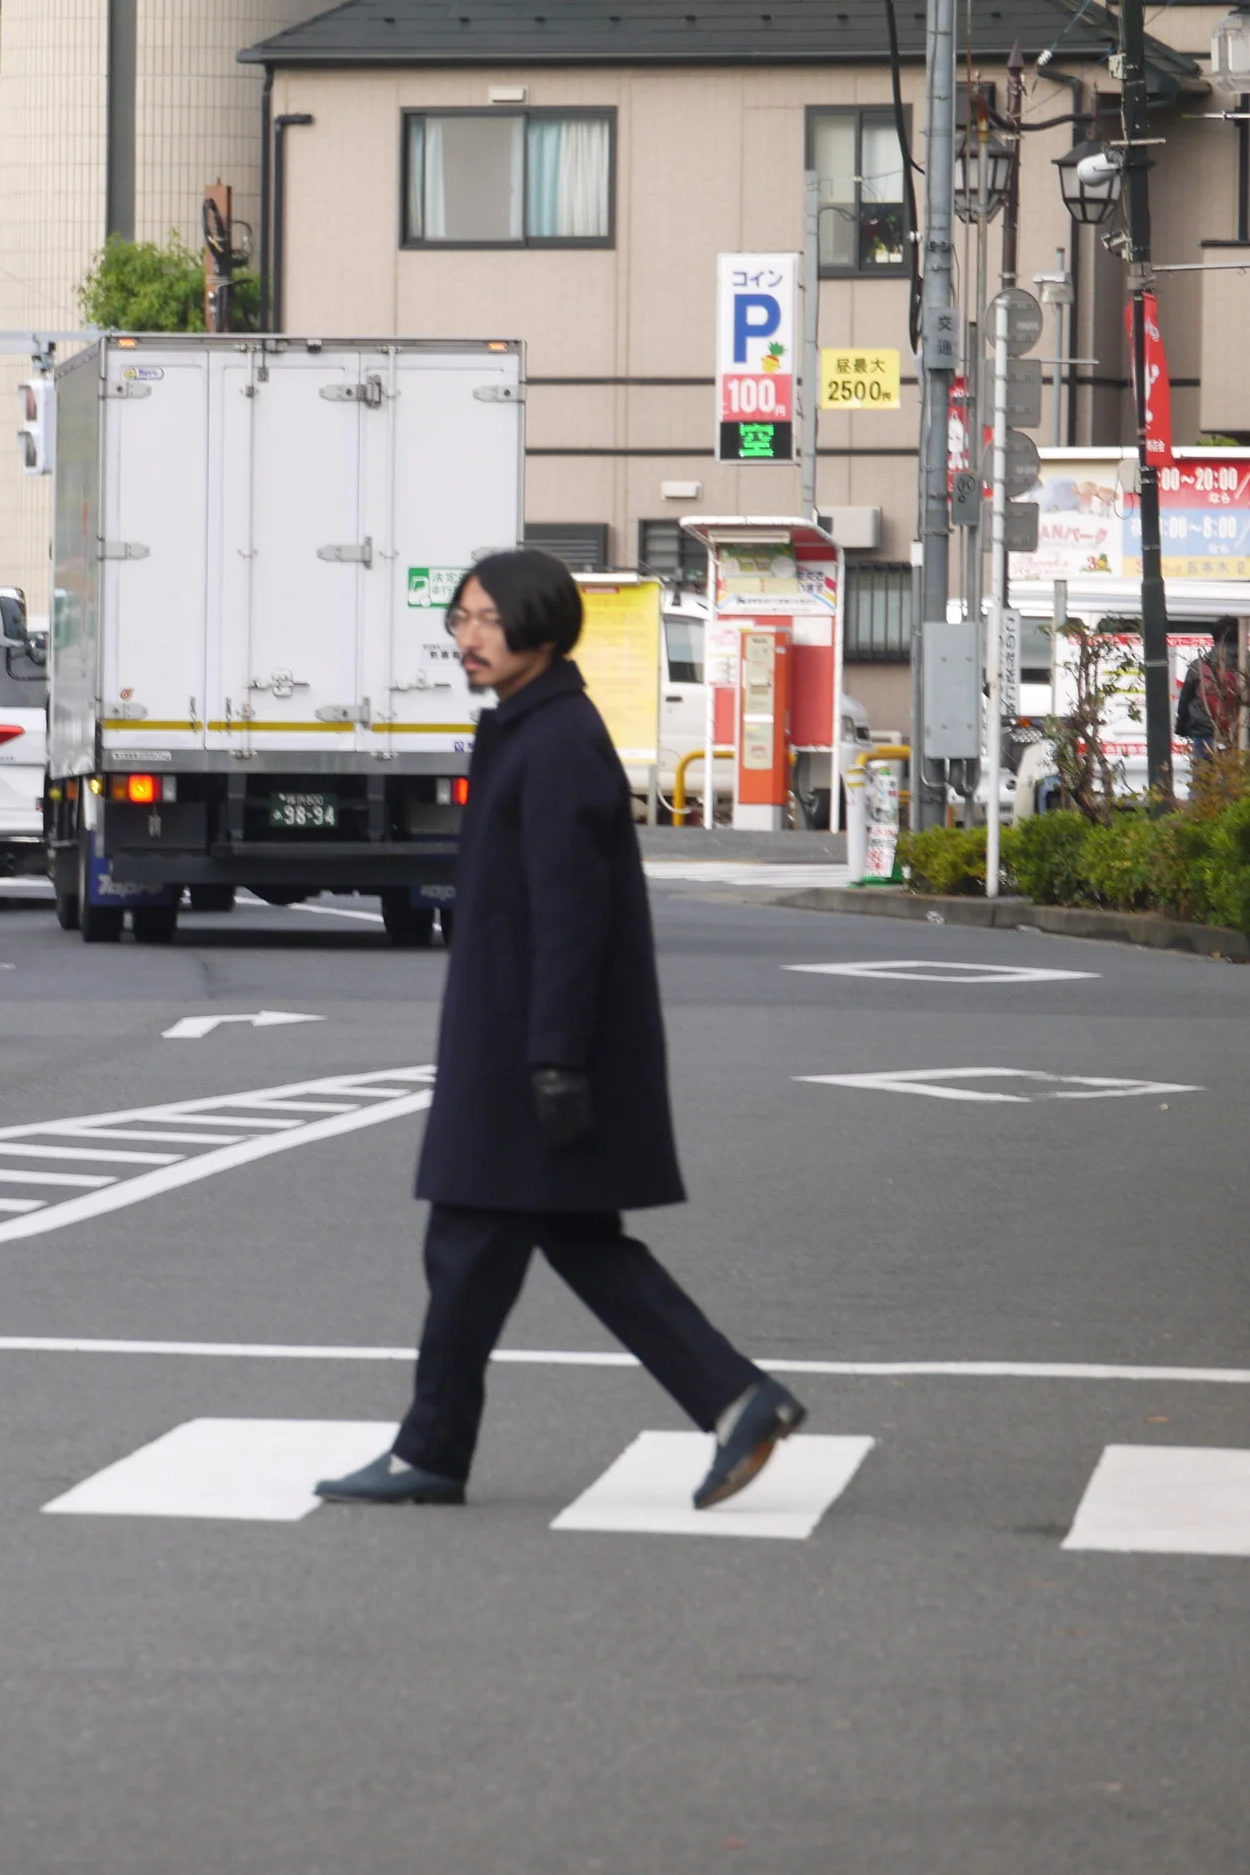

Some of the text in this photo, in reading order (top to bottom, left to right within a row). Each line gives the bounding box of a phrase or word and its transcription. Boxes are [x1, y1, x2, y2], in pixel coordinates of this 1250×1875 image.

[732, 270, 783, 288] コイン
[733, 293, 782, 364] P
[836, 358, 886, 375] 昼最大
[738, 422, 774, 457] 空
[1038, 524, 1109, 545] ANパーク
[283, 804, 335, 827] 98-94
